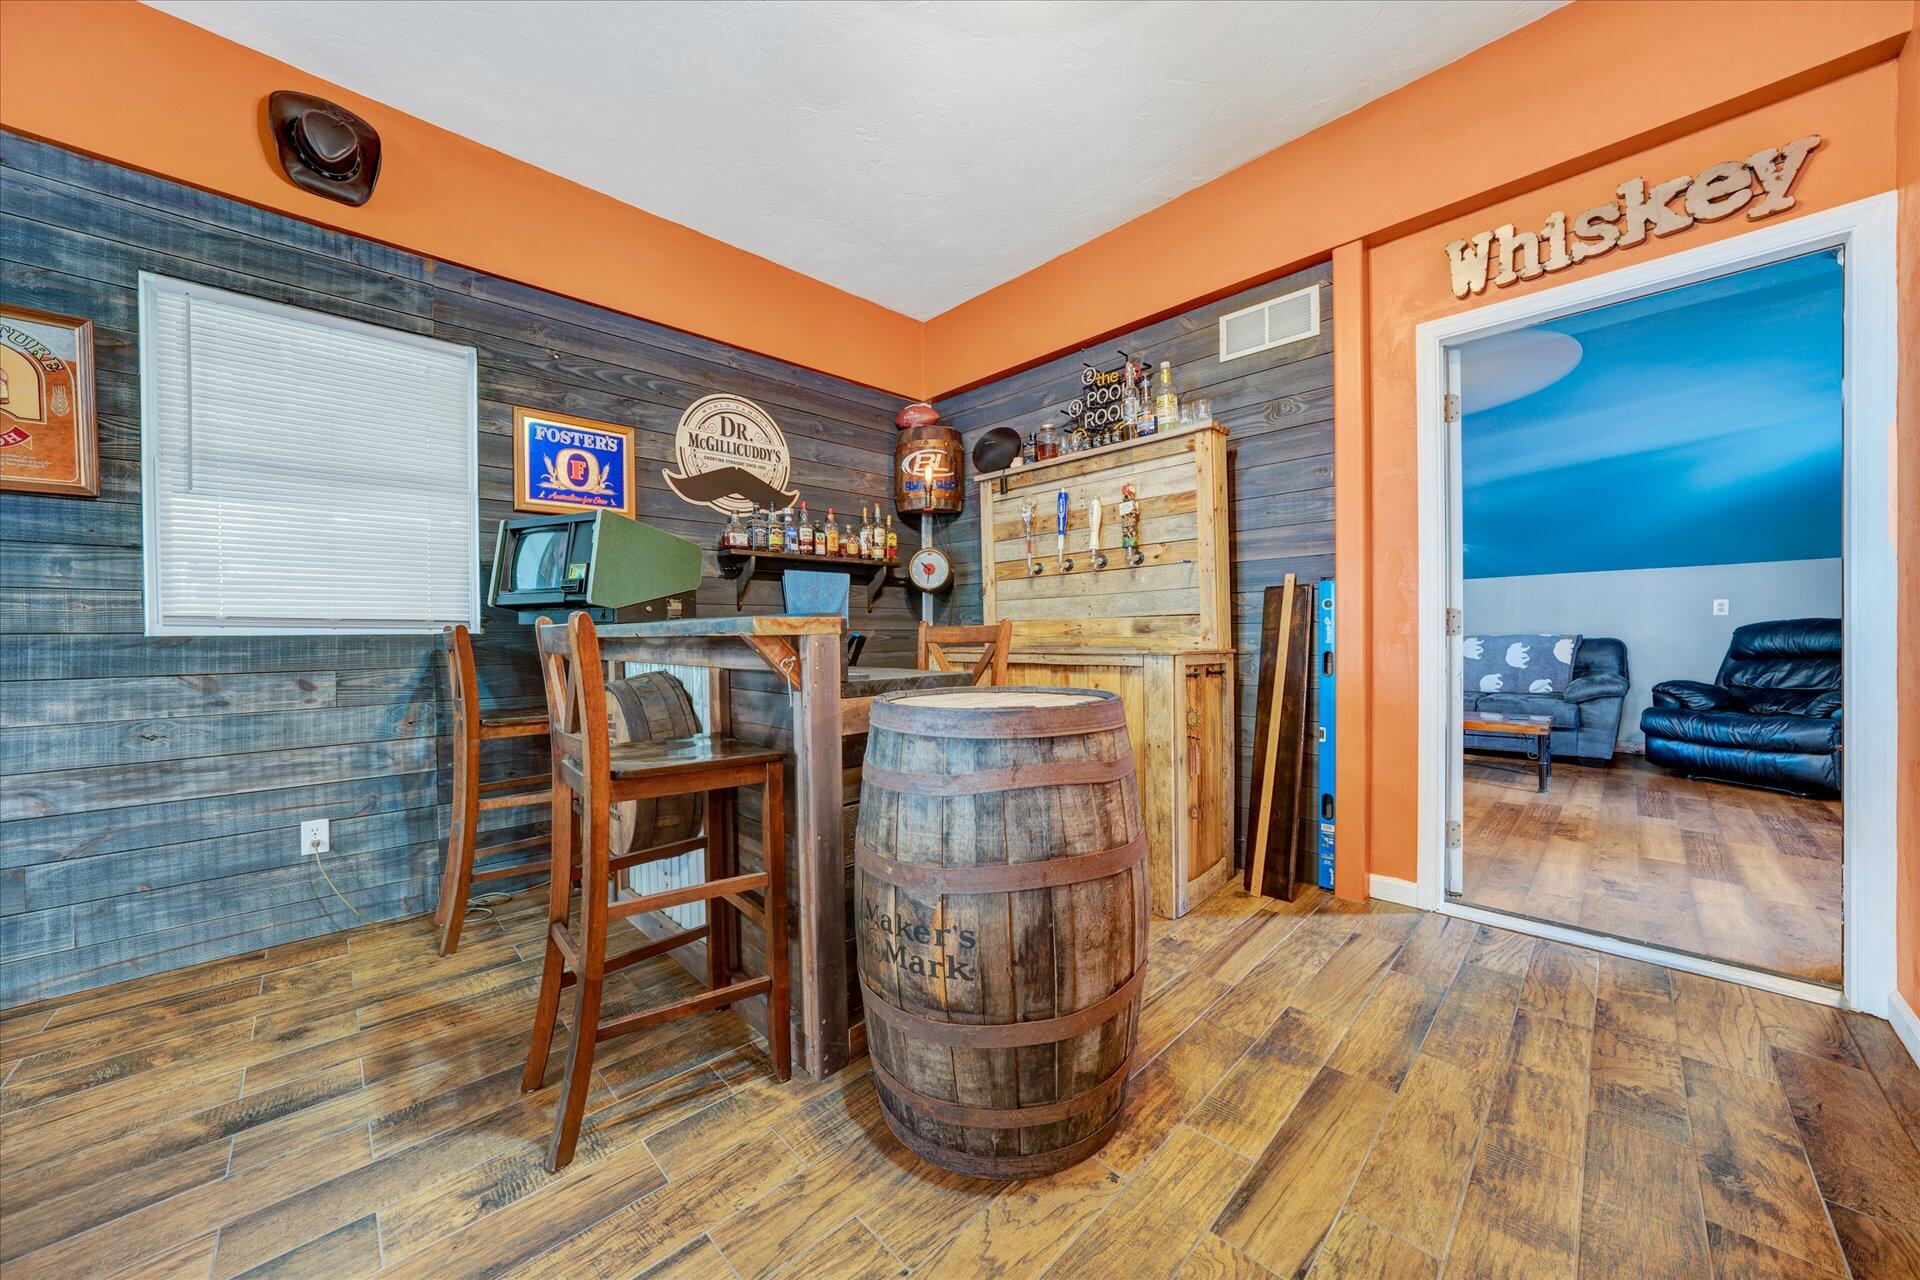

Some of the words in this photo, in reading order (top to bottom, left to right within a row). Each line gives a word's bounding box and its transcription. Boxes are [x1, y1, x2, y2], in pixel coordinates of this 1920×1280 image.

[1445, 134, 1822, 300] Whiskey
[1095, 370, 1119, 387] the
[534, 425, 619, 453] FOSTER'S
[719, 415, 754, 442] DR.
[569, 459, 587, 481] F
[864, 896, 977, 949] Maker's
[882, 938, 975, 982] Mark
